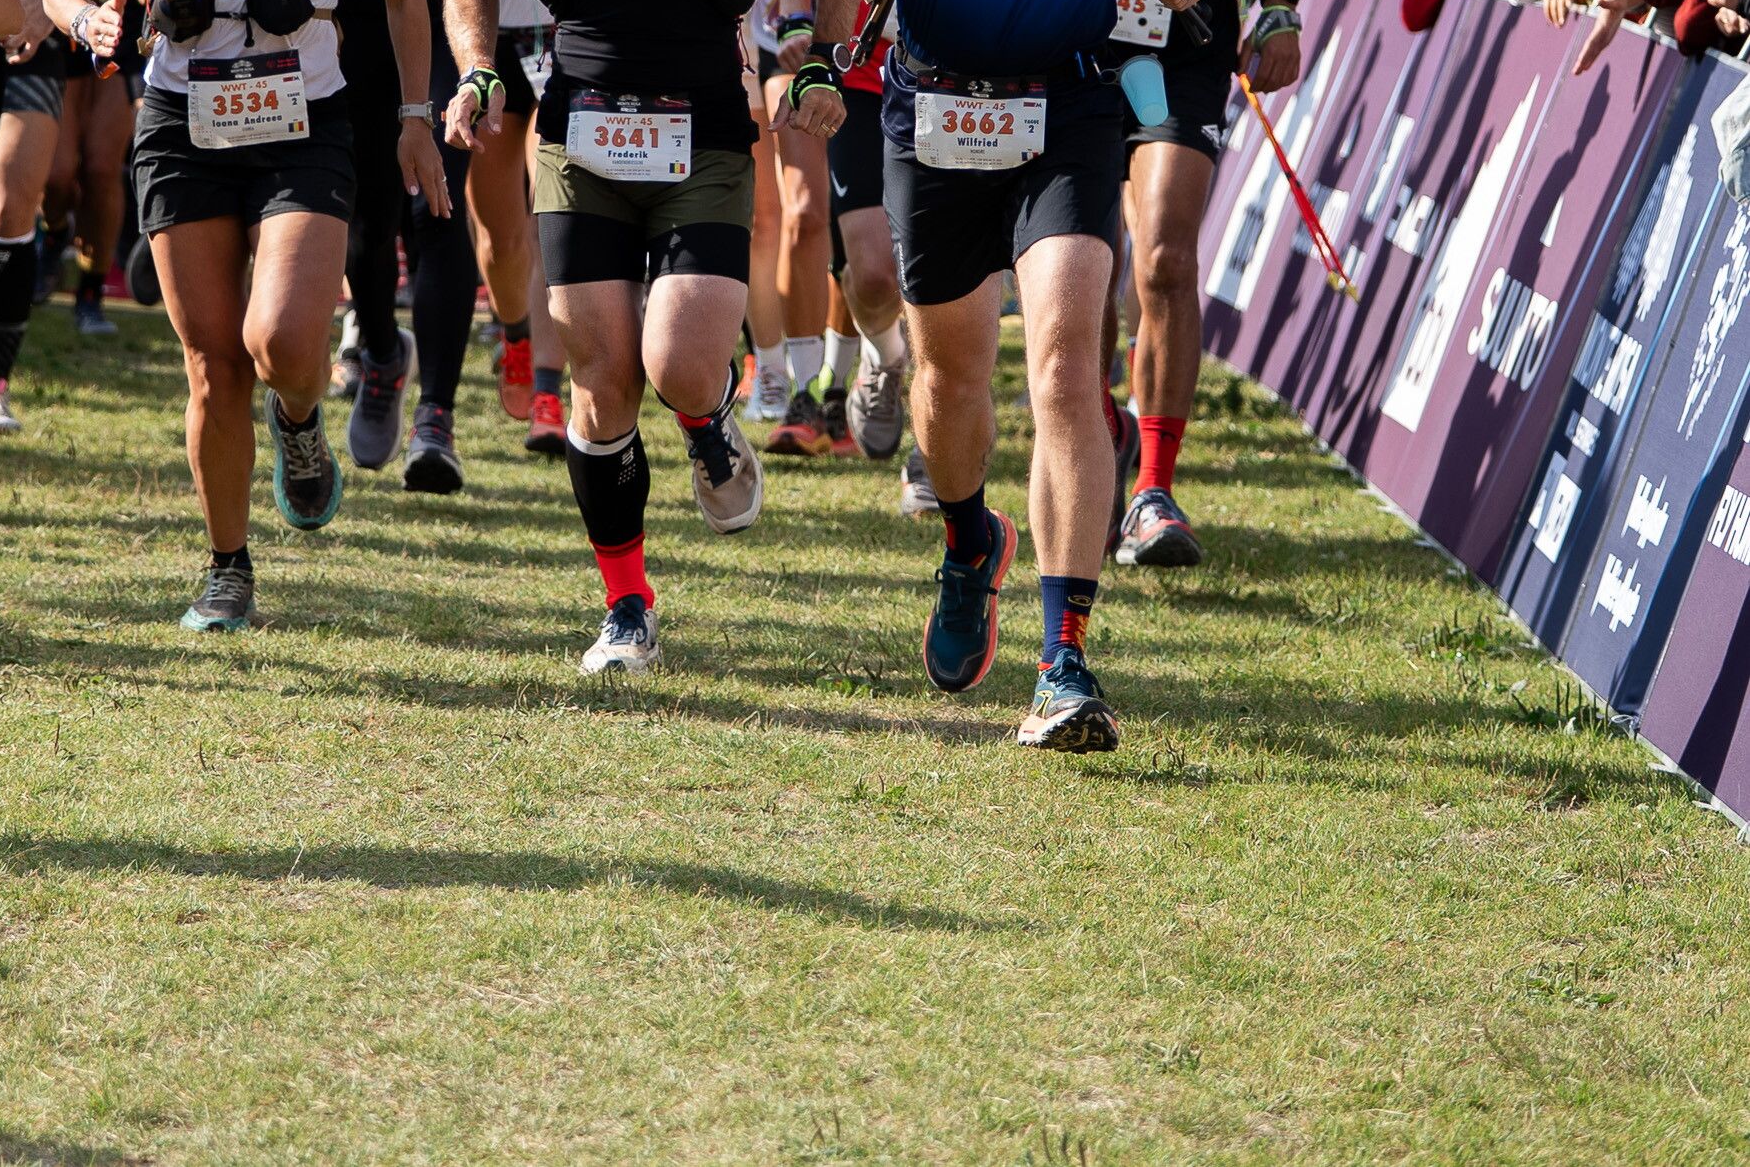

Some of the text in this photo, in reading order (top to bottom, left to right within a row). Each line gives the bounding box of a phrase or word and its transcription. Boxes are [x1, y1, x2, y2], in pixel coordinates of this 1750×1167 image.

[221, 83, 247, 92] WWT
[255, 81, 268, 89] 45
[212, 90, 279, 116] 3534
[955, 100, 983, 110] WWT
[992, 102, 1006, 111] 45
[244, 114, 283, 125] Andreea
[605, 116, 632, 125] WWT
[640, 117, 653, 125] 45
[941, 110, 1015, 135] 3662
[1028, 125, 1035, 134] 2
[594, 125, 659, 148] 3641
[957, 137, 999, 147] Wilfried
[607, 150, 648, 159] Frederik
[1467, 266, 1558, 392] SUUNTO
